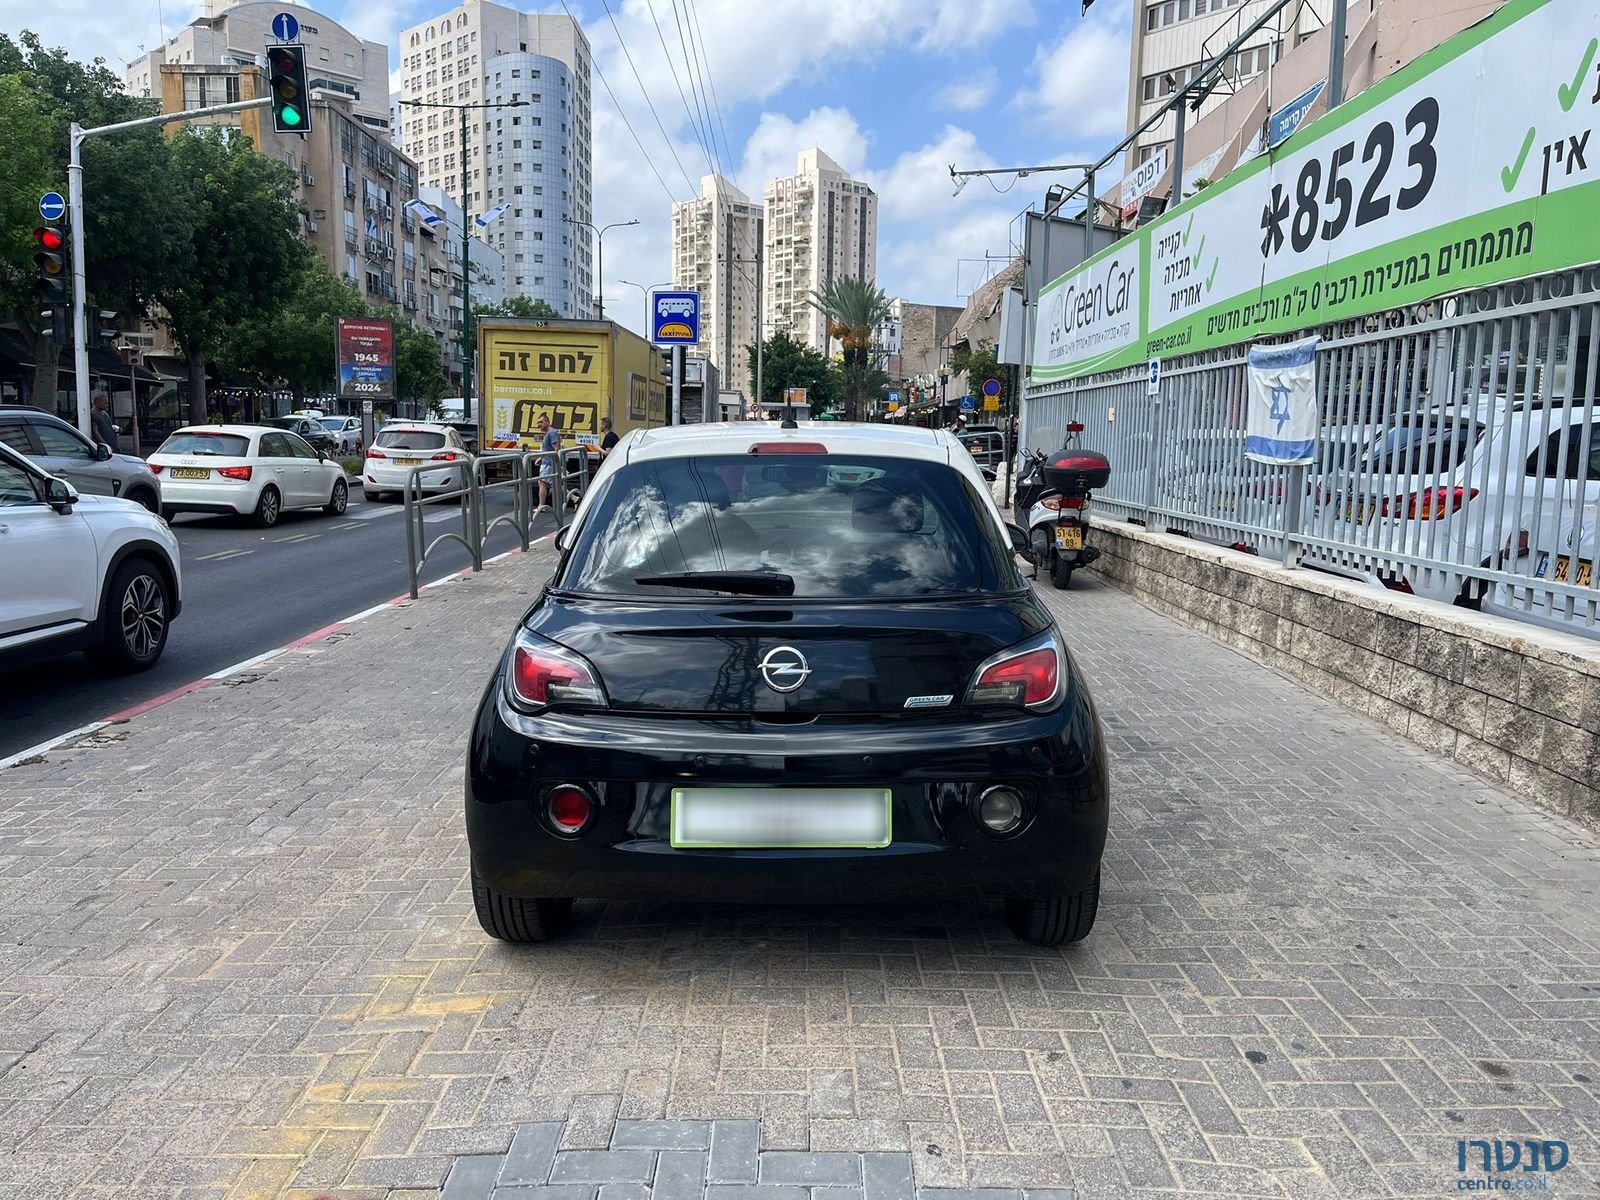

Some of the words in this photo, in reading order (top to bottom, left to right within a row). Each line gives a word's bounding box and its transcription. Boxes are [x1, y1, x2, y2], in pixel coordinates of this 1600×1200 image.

[1137, 157, 1161, 188] דפוס
[1540, 129, 1591, 196] אין
[1158, 231, 1181, 259] קנייה
[1437, 221, 1533, 276] מתמחים
[1164, 256, 1190, 285] מכירה
[1360, 252, 1430, 298] במכירת
[1064, 285, 1103, 334] Green
[1106, 260, 1135, 317] Car
[1169, 282, 1203, 313] אחריות
[1324, 275, 1357, 307] רכבי
[1207, 309, 1240, 336] חדשים
[1243, 297, 1280, 327] ורכבים
[1146, 325, 1192, 358] green-car.co.il
[354, 353, 379, 362] 1945
[499, 351, 530, 371] זה
[539, 351, 593, 374] לחם
[354, 383, 381, 392] 2024
[493, 384, 552, 395] berman.co.il
[520, 403, 593, 433] ברמן
